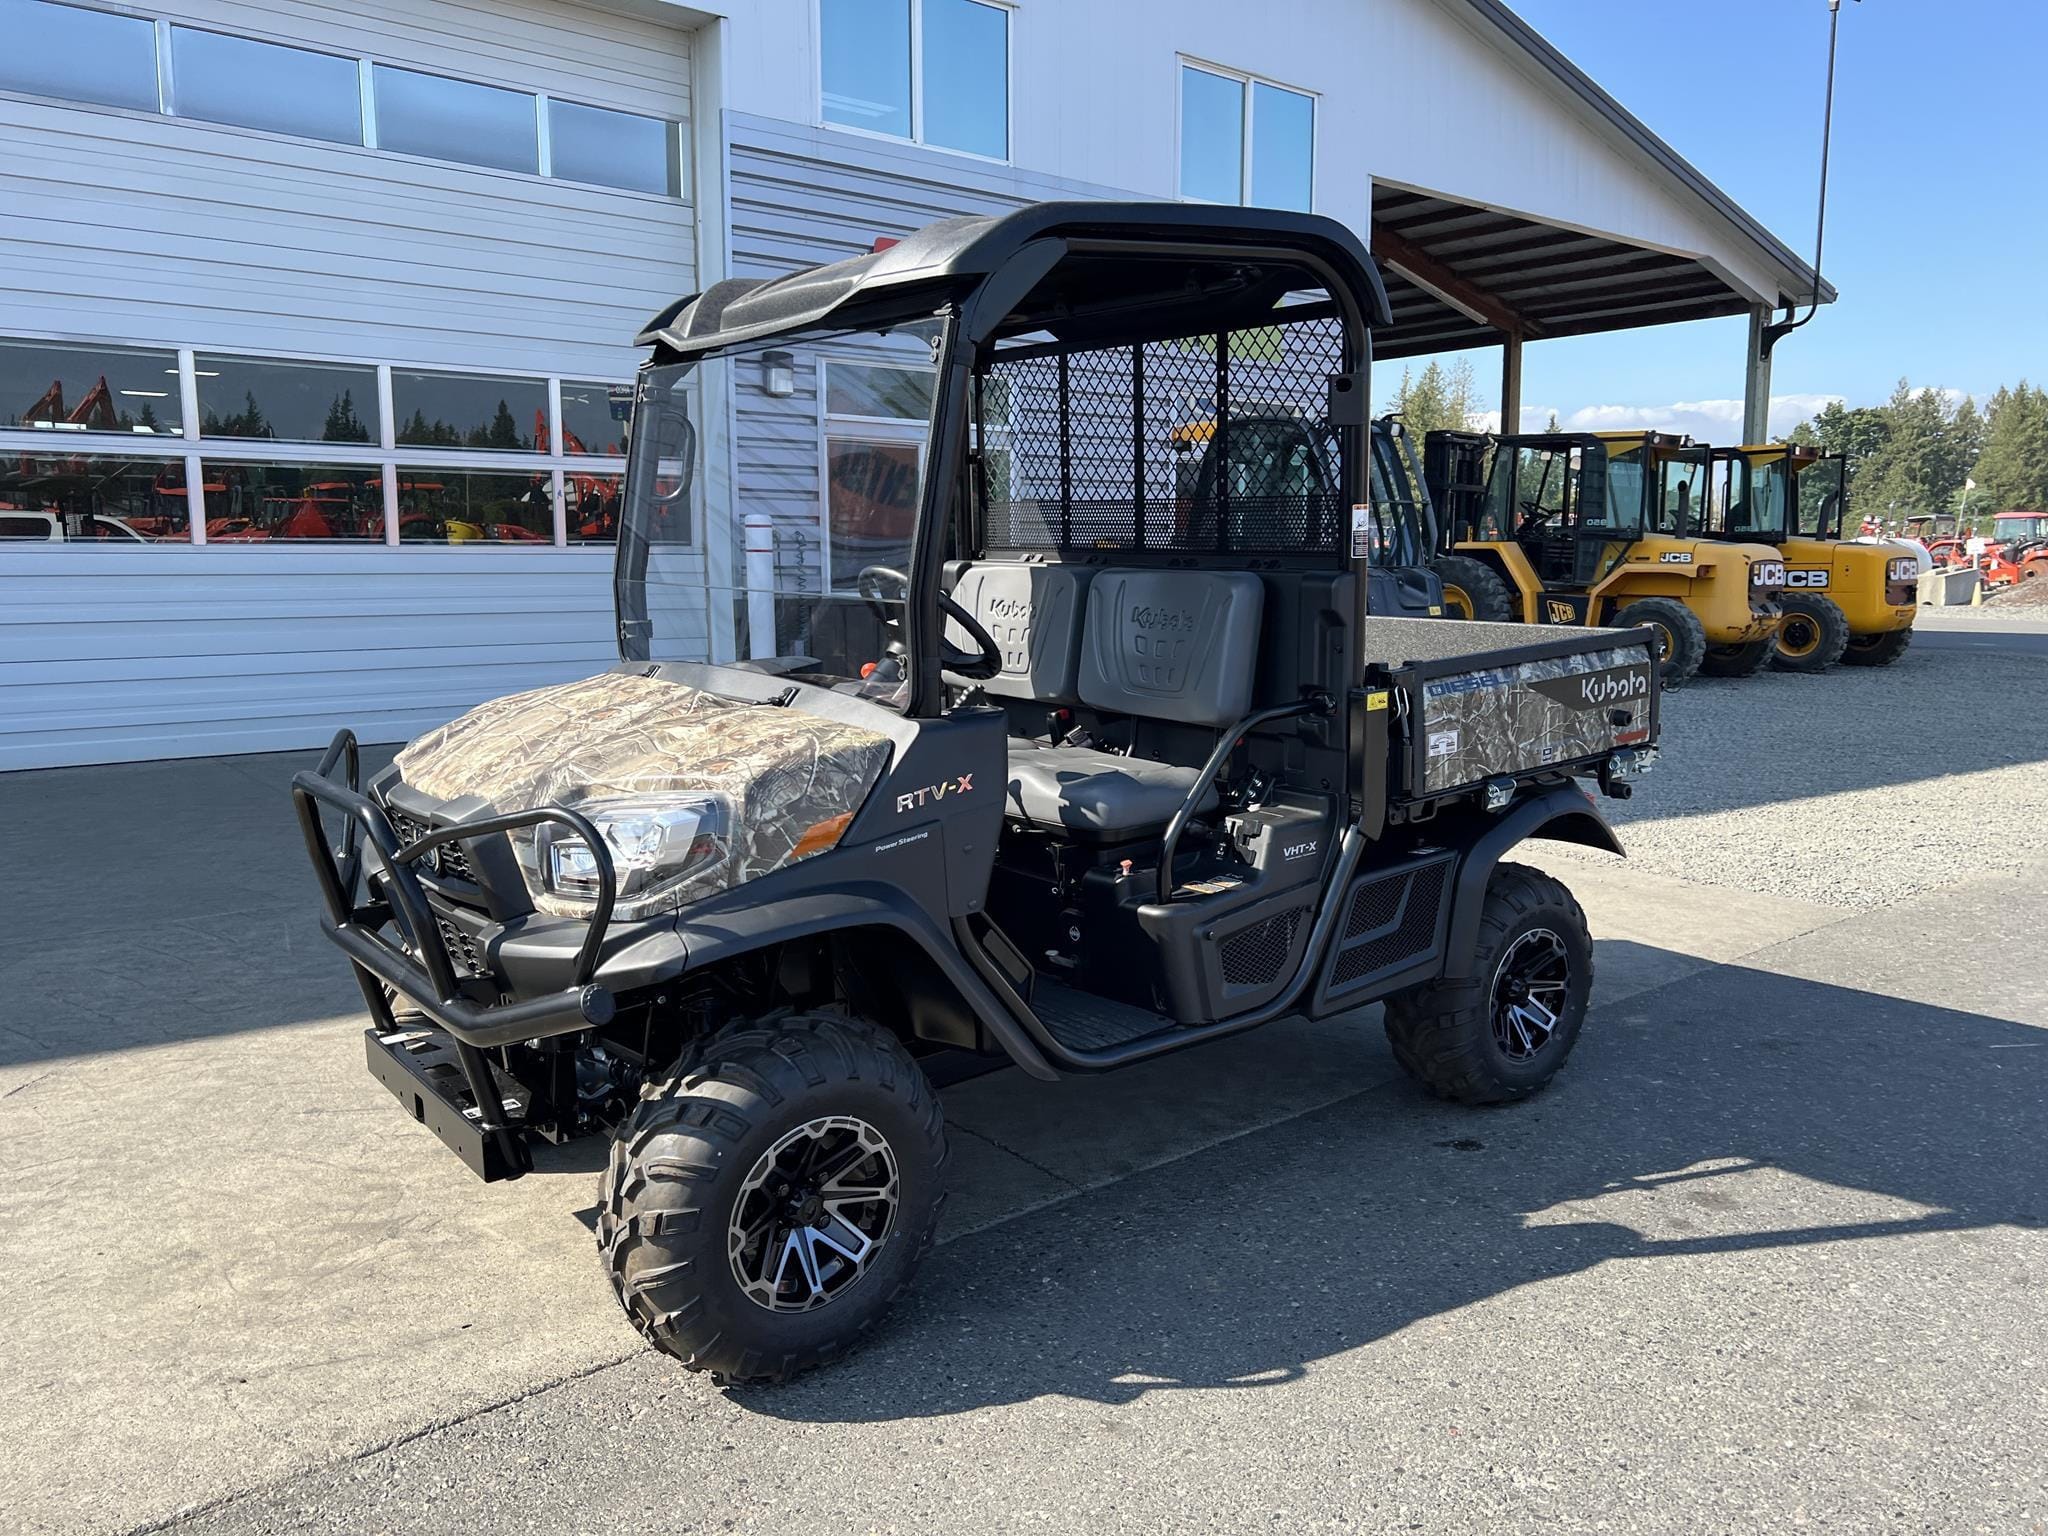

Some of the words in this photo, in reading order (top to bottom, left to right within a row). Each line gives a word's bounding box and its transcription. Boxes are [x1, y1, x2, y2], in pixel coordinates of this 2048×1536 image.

[1659, 552, 1692, 563] JCB
[1753, 564, 1784, 586] JCB
[1890, 561, 1918, 580] JCB
[1551, 603, 1574, 622] JCB
[1428, 673, 1511, 697] DIESEL
[1582, 670, 1646, 703] Kubota
[897, 773, 973, 813] RTV-X
[875, 841, 898, 852] Power
[898, 832, 928, 845] Steering
[1283, 841, 1317, 857] VHT-X
